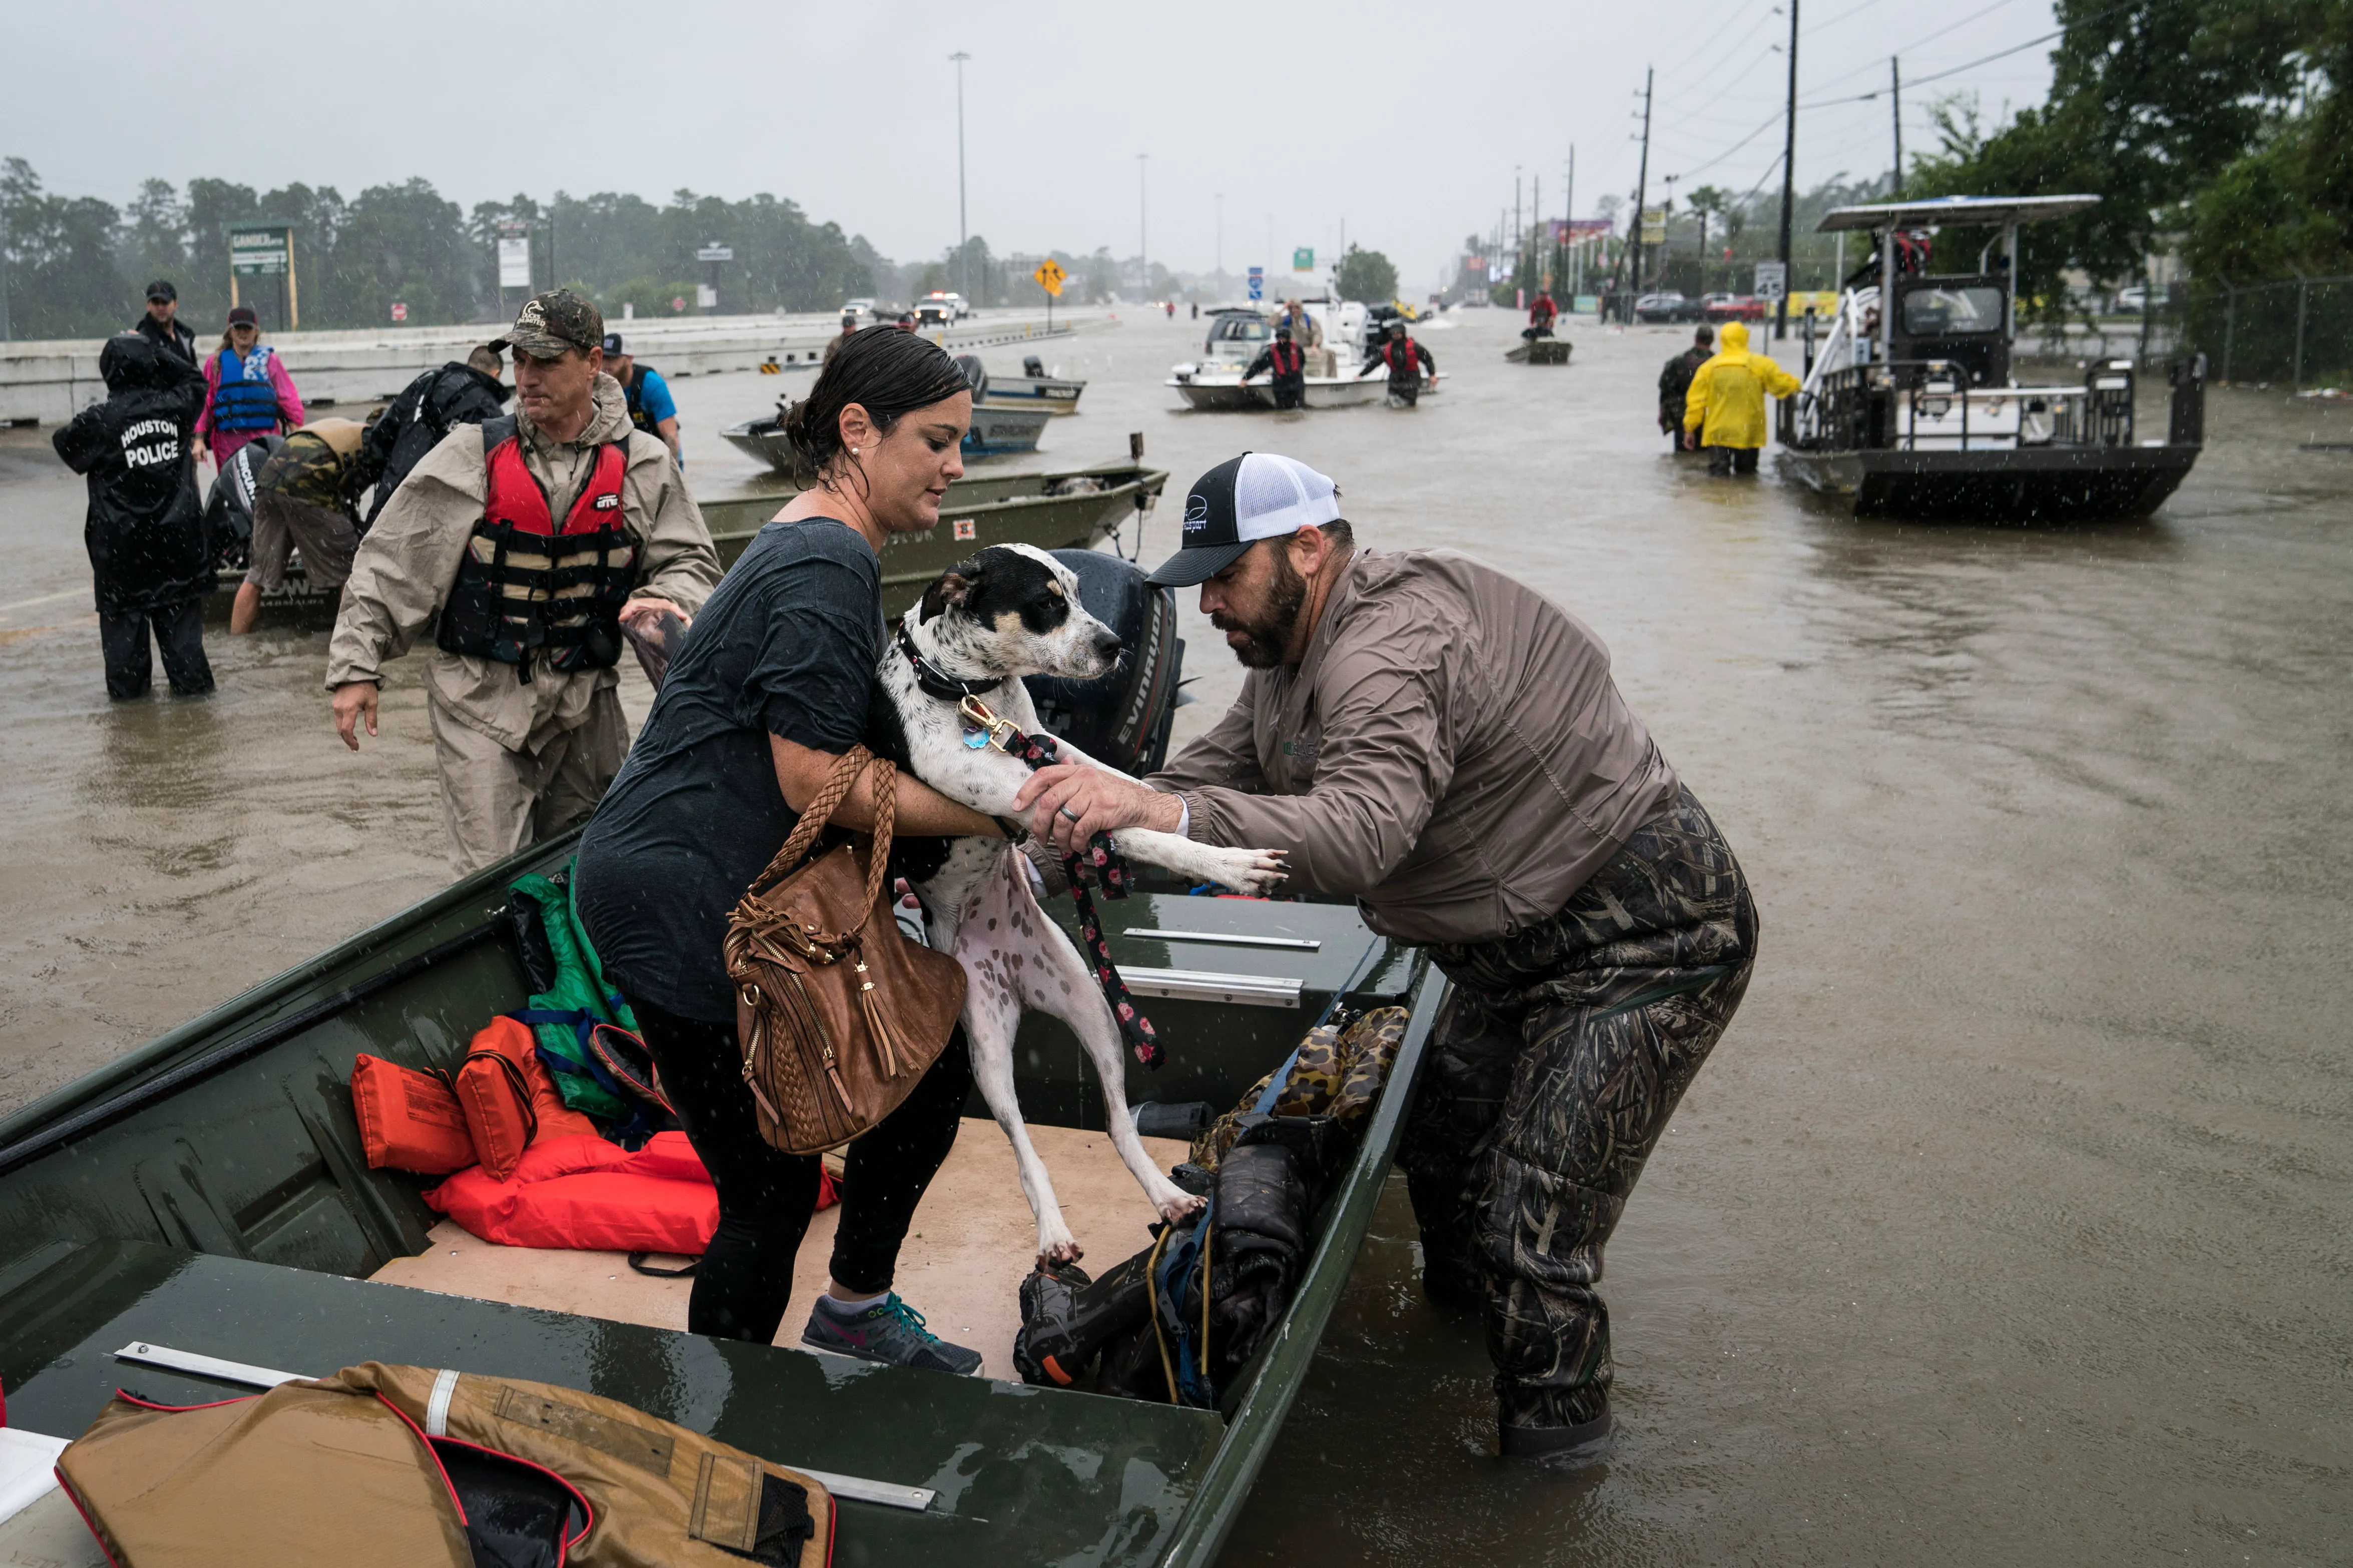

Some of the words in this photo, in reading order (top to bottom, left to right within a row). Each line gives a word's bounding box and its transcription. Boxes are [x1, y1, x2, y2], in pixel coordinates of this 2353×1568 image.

[1757, 282, 1783, 297] 45
[121, 419, 178, 448] HOUSTON
[125, 440, 179, 468] POLICE
[238, 447, 256, 500] MERCUR
[1118, 595, 1161, 744] EVINRUDE
